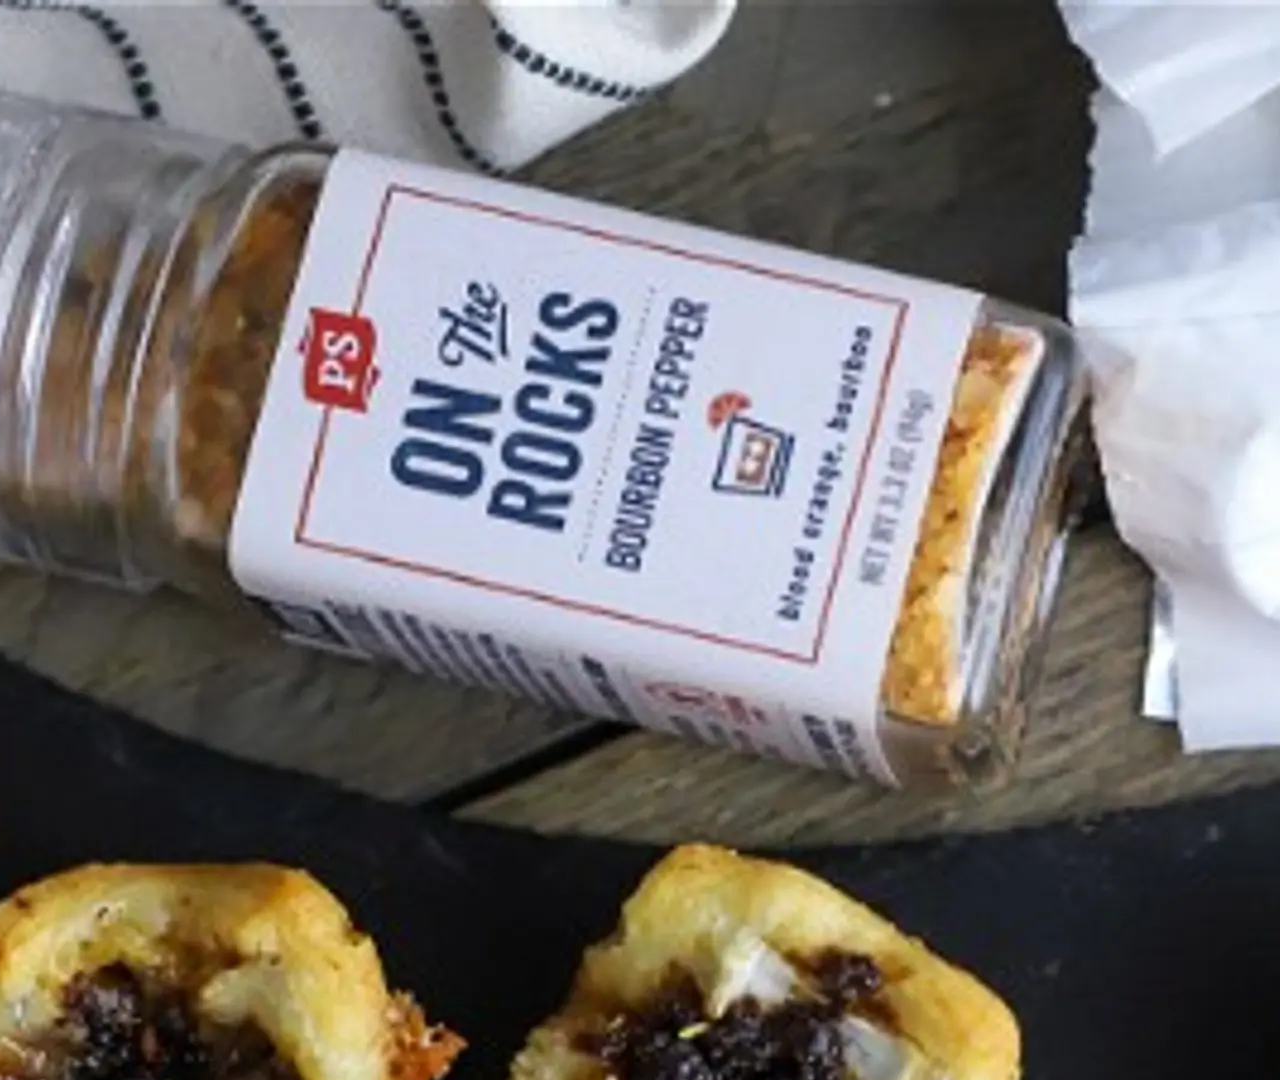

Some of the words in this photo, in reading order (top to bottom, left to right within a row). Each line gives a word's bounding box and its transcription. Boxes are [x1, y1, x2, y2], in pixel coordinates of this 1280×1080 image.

[318, 330, 361, 393] PS
[438, 280, 508, 367] The
[390, 379, 502, 497] ON
[486, 292, 619, 532] ROCKS
[605, 423, 675, 572] BOURBON
[645, 297, 710, 419] PEPPER
[776, 547, 814, 621] blood
[826, 325, 872, 433] bourbon
[859, 547, 891, 585] NET
